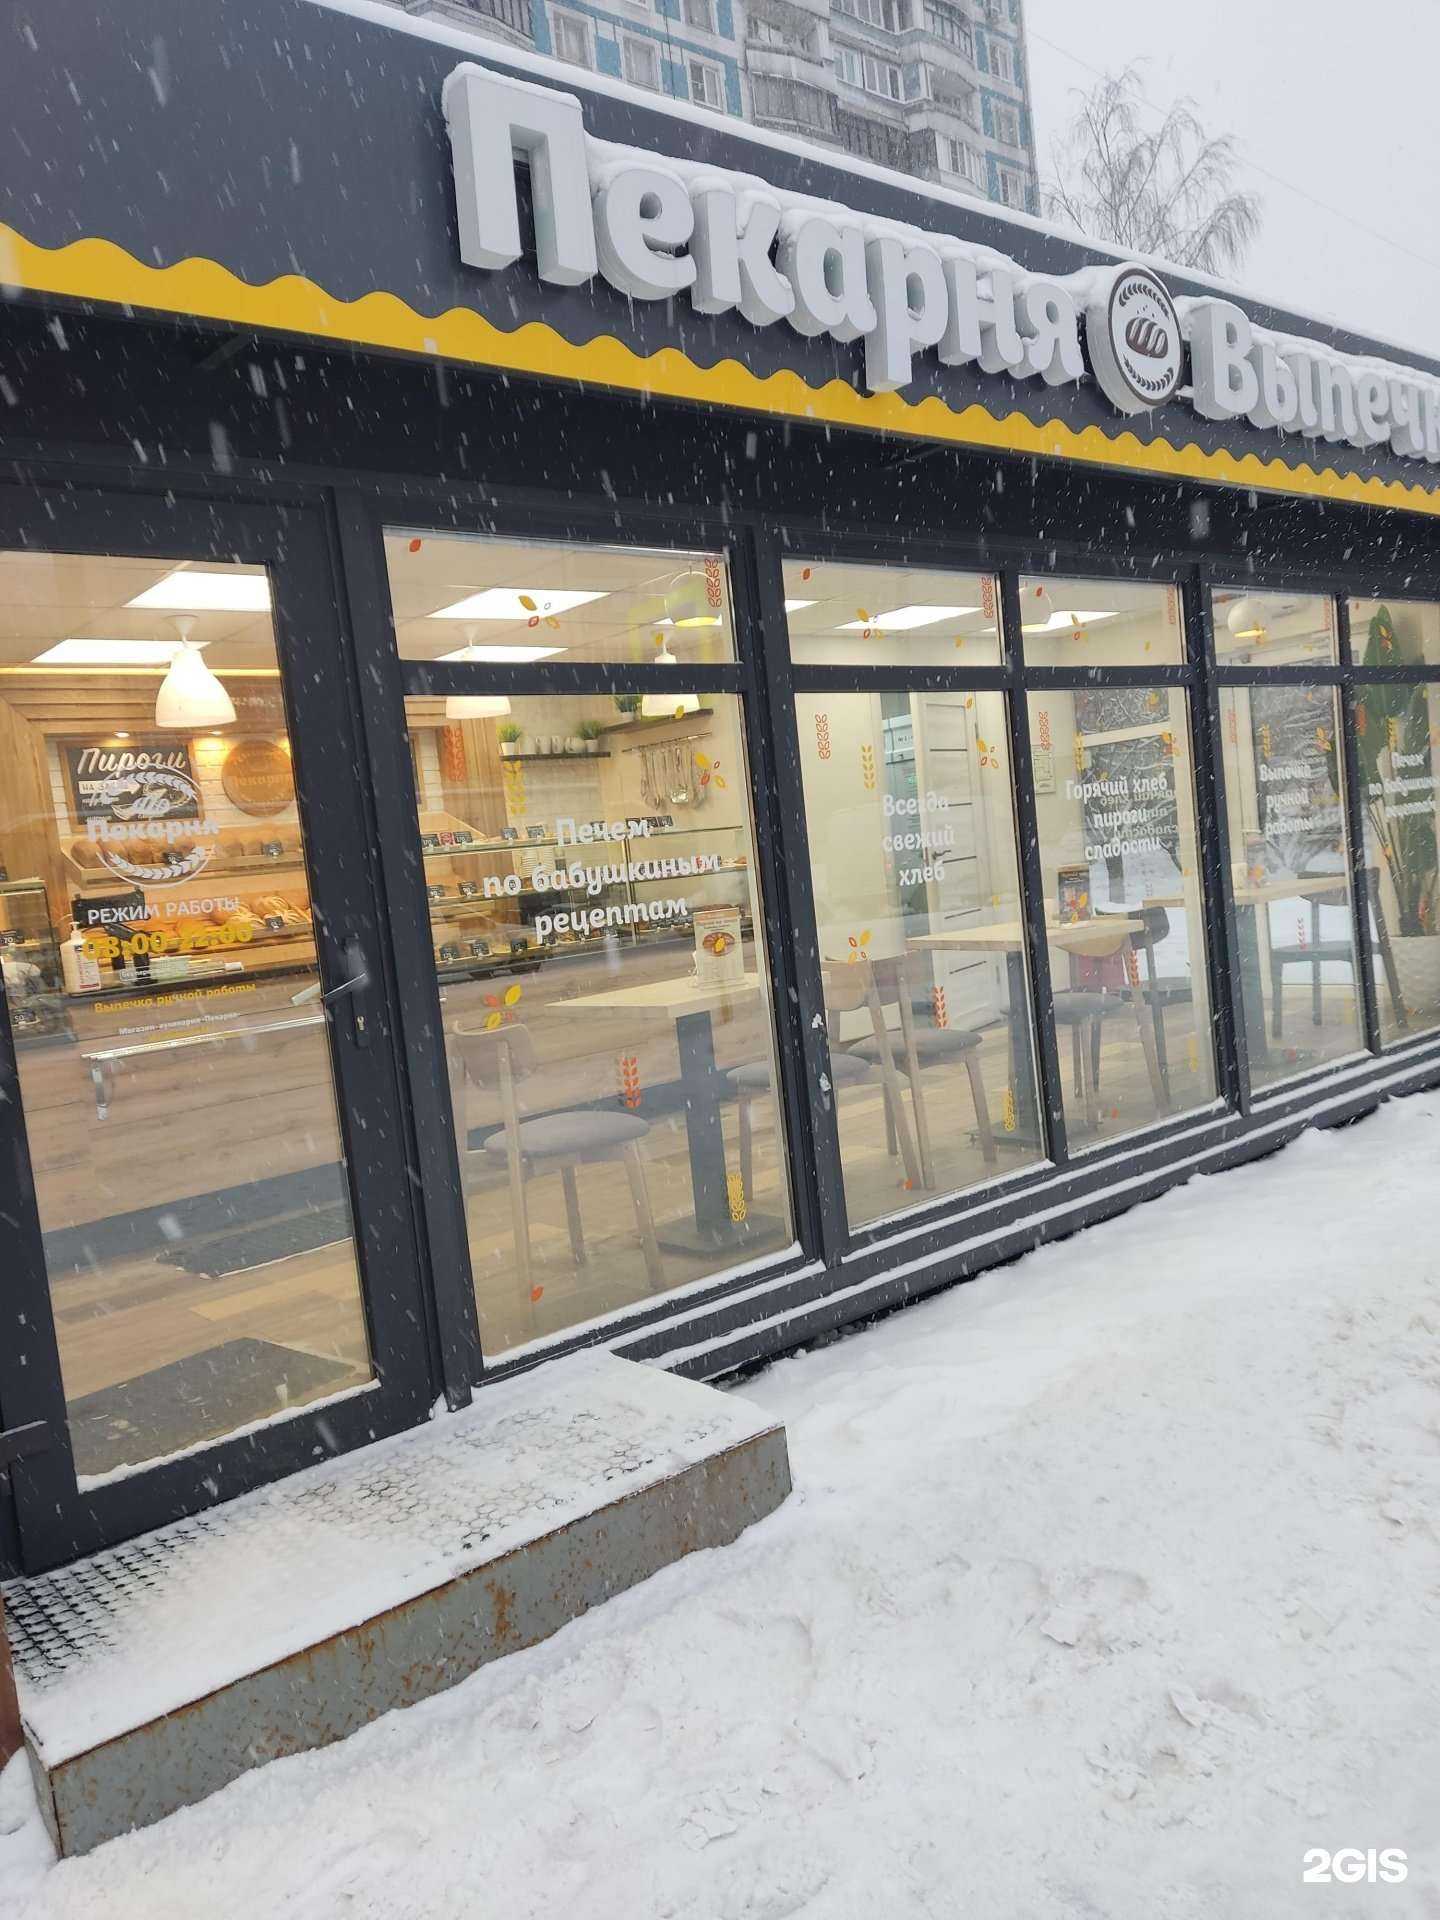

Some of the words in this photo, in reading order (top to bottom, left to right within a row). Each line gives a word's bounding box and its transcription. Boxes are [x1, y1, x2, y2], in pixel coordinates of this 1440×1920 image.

[446, 66, 1086, 393] Пекарня
[77, 748, 186, 778] Пироги
[1065, 775, 1128, 804] Горячий
[1133, 772, 1168, 793] хлеб
[86, 818, 221, 844] Пекарня
[555, 816, 651, 847] Печем
[1093, 807, 1149, 831] пироги
[882, 824, 956, 852] свежий
[1084, 836, 1162, 861] сладости
[483, 873, 522, 898] по
[531, 853, 722, 895] бабушкиным
[898, 861, 946, 887] хлеб
[87, 906, 161, 925] РЕЖИМ
[166, 896, 241, 916] РАБОТЫ
[534, 896, 689, 945] рецептам
